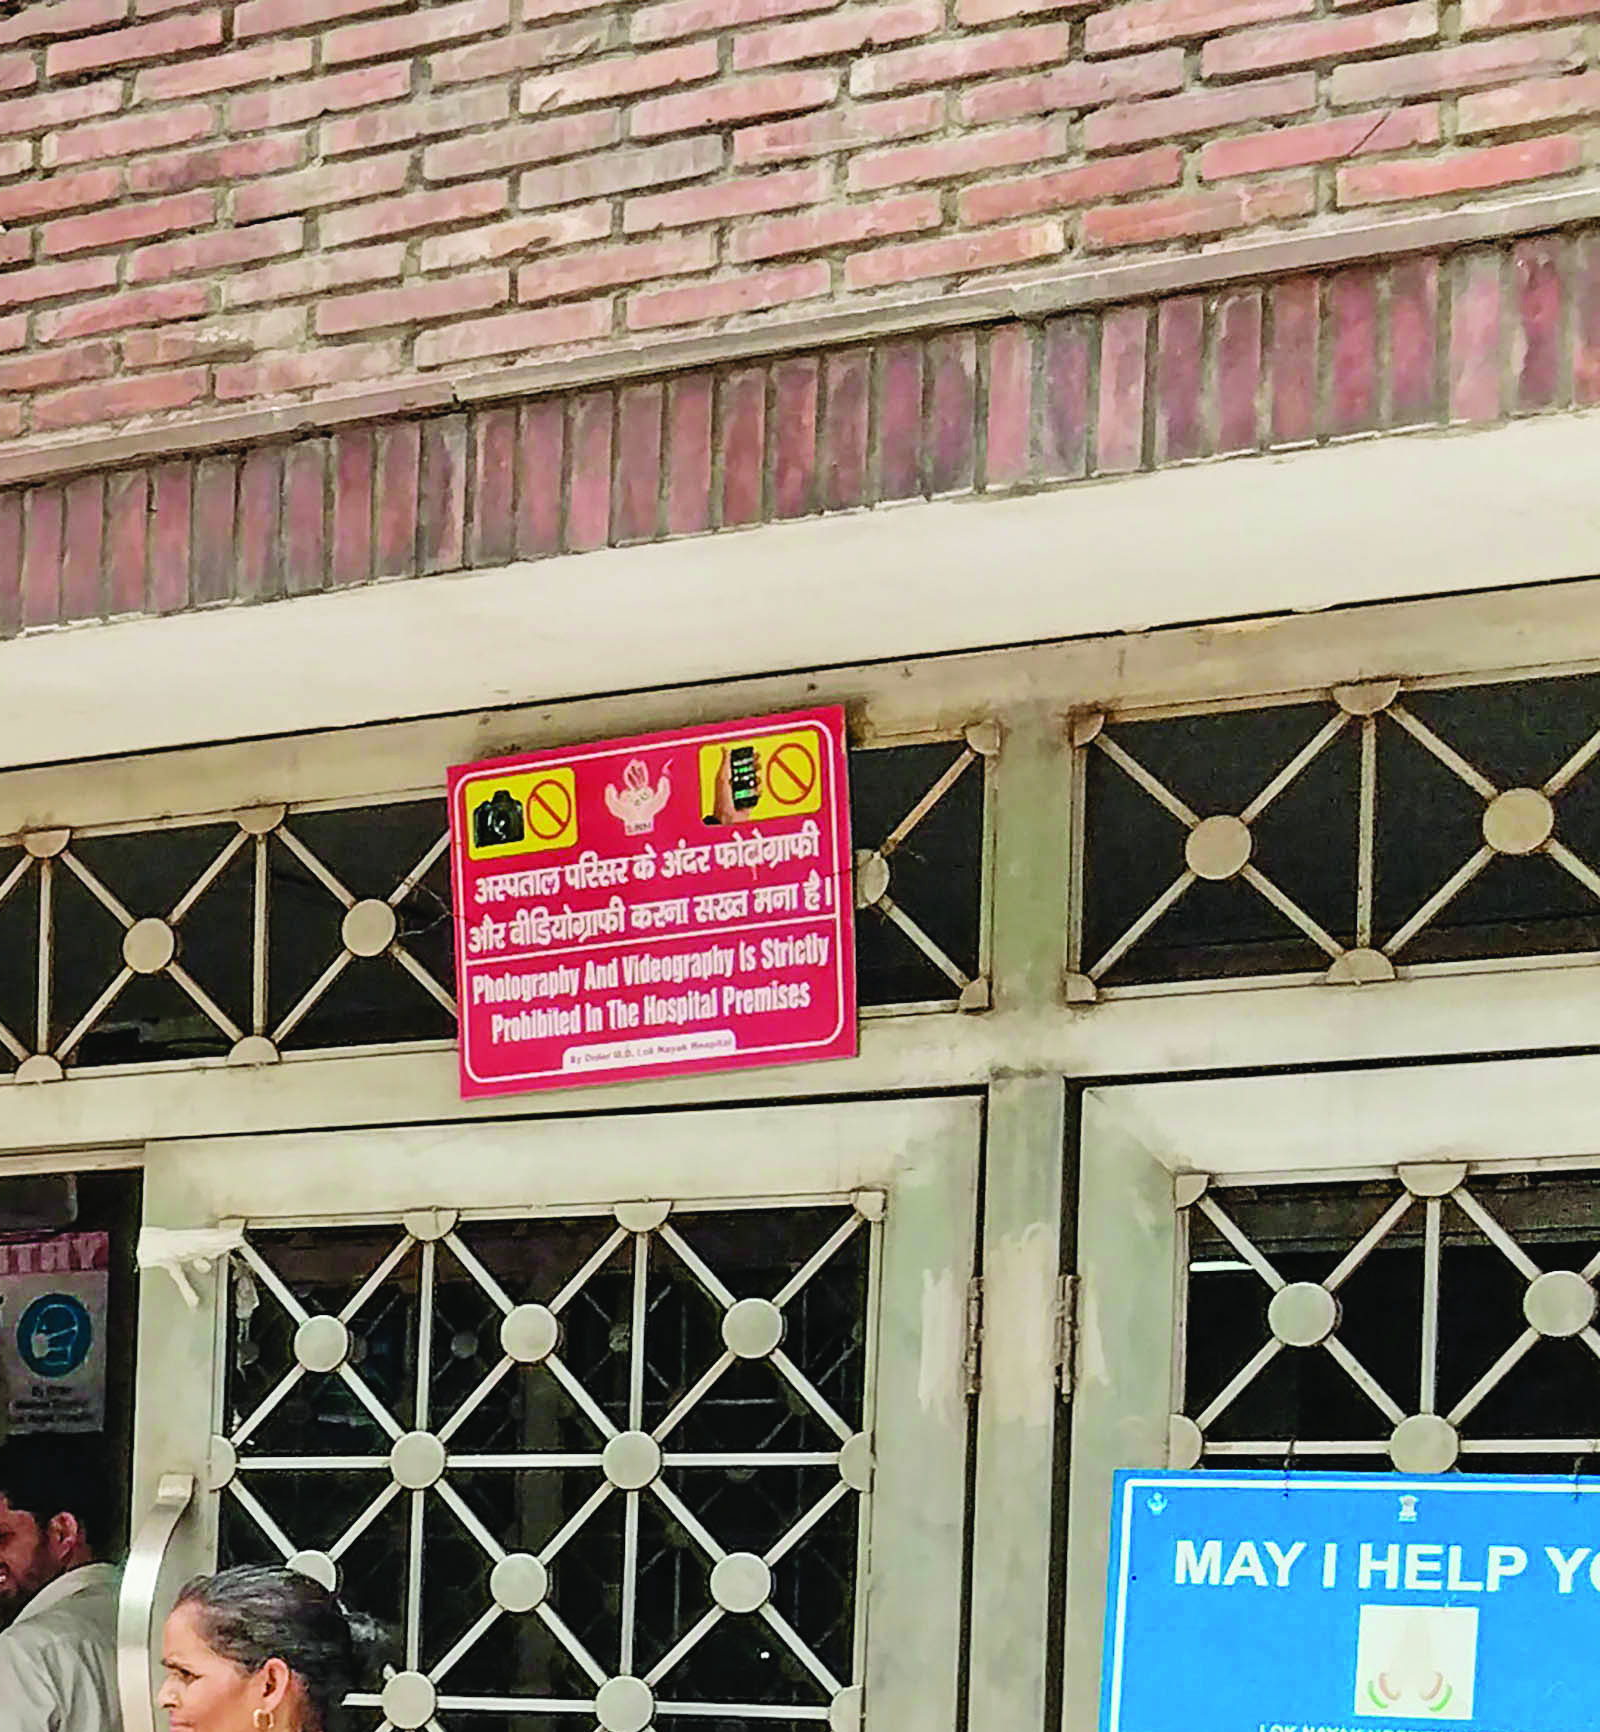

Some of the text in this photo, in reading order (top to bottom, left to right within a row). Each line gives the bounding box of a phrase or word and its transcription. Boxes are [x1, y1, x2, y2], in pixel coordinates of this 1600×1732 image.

[475, 819, 820, 904] अस्पताल परिसर के अंदर फोटोग्राफी
[468, 913, 506, 953] और
[510, 895, 626, 946] वीडियोग्राफी
[629, 898, 690, 929] करना
[752, 883, 799, 913] मना
[472, 932, 830, 1005] Photography And Videography Is Strictly
[491, 980, 811, 1044] Prohibited In The Hospital Premises
[1174, 1540, 1600, 1594] MAY I HELP Y
